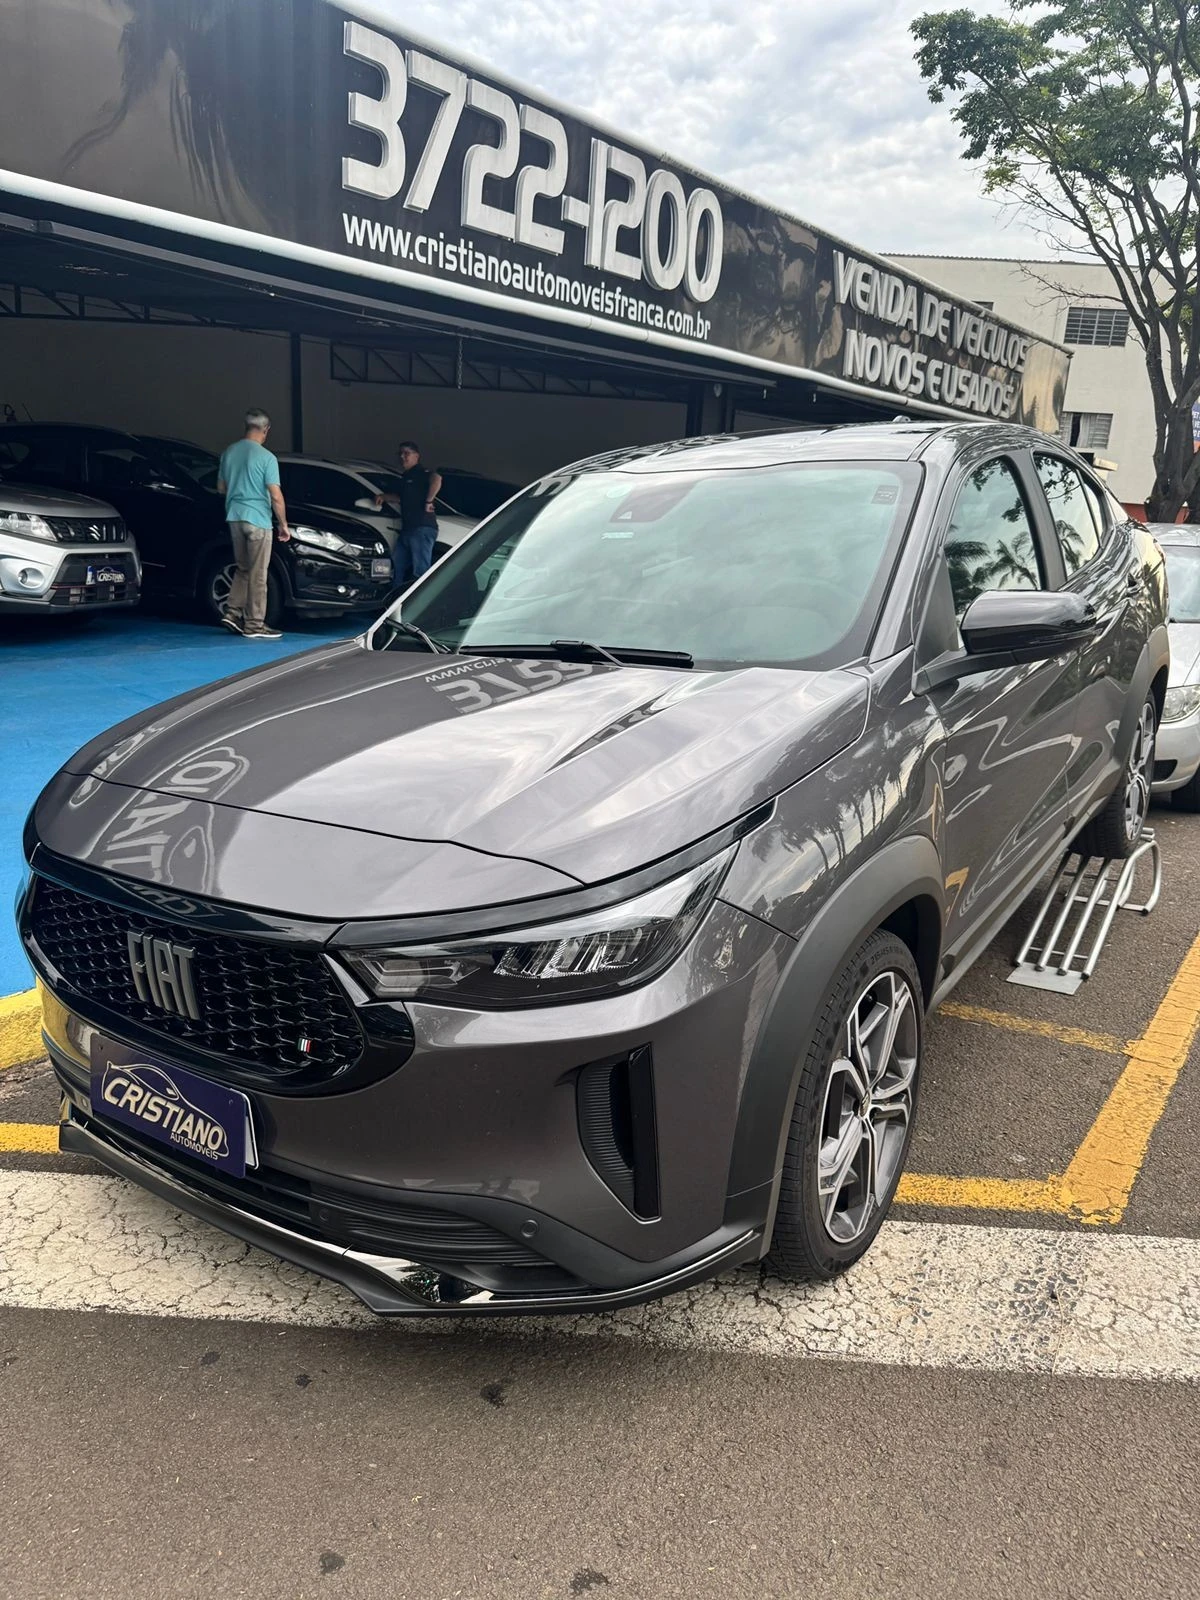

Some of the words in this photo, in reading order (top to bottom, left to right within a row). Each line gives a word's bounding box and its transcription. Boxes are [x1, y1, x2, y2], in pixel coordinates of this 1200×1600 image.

[342, 21, 723, 302] 3722-1200
[342, 212, 711, 340] www.cristianoautomoveisfranca.com.br
[833, 249, 918, 332] VENDA
[919, 292, 953, 344] DE
[843, 328, 928, 396] NOVOS
[925, 358, 944, 401] E
[941, 362, 1014, 419] USADOS
[127, 930, 200, 1020] FIAT
[104, 1077, 223, 1150] CRISTIANO
